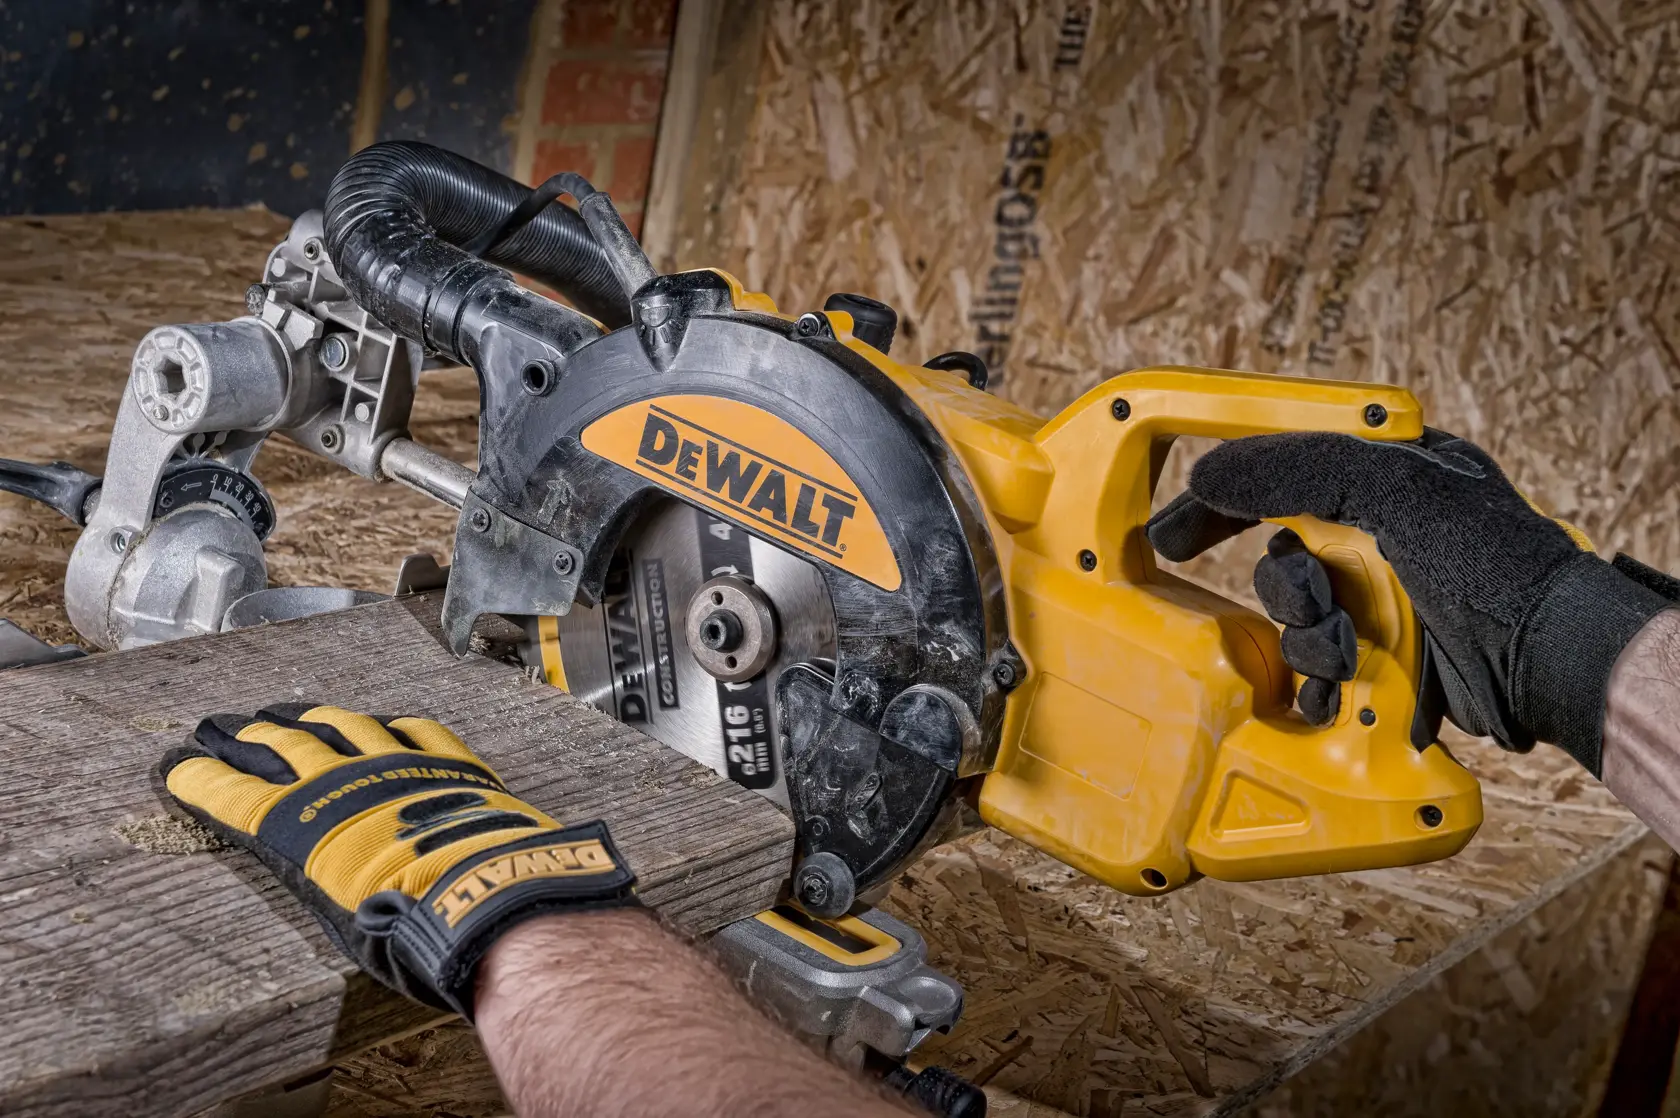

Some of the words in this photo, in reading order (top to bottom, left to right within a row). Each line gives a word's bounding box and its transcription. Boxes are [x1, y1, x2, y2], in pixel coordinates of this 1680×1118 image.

[224, 476, 233, 485] 10
[235, 481, 245, 491] 20
[245, 490, 255, 501] 30
[646, 563, 675, 706] CONSTRUCTION
[754, 741, 770, 772] mm
